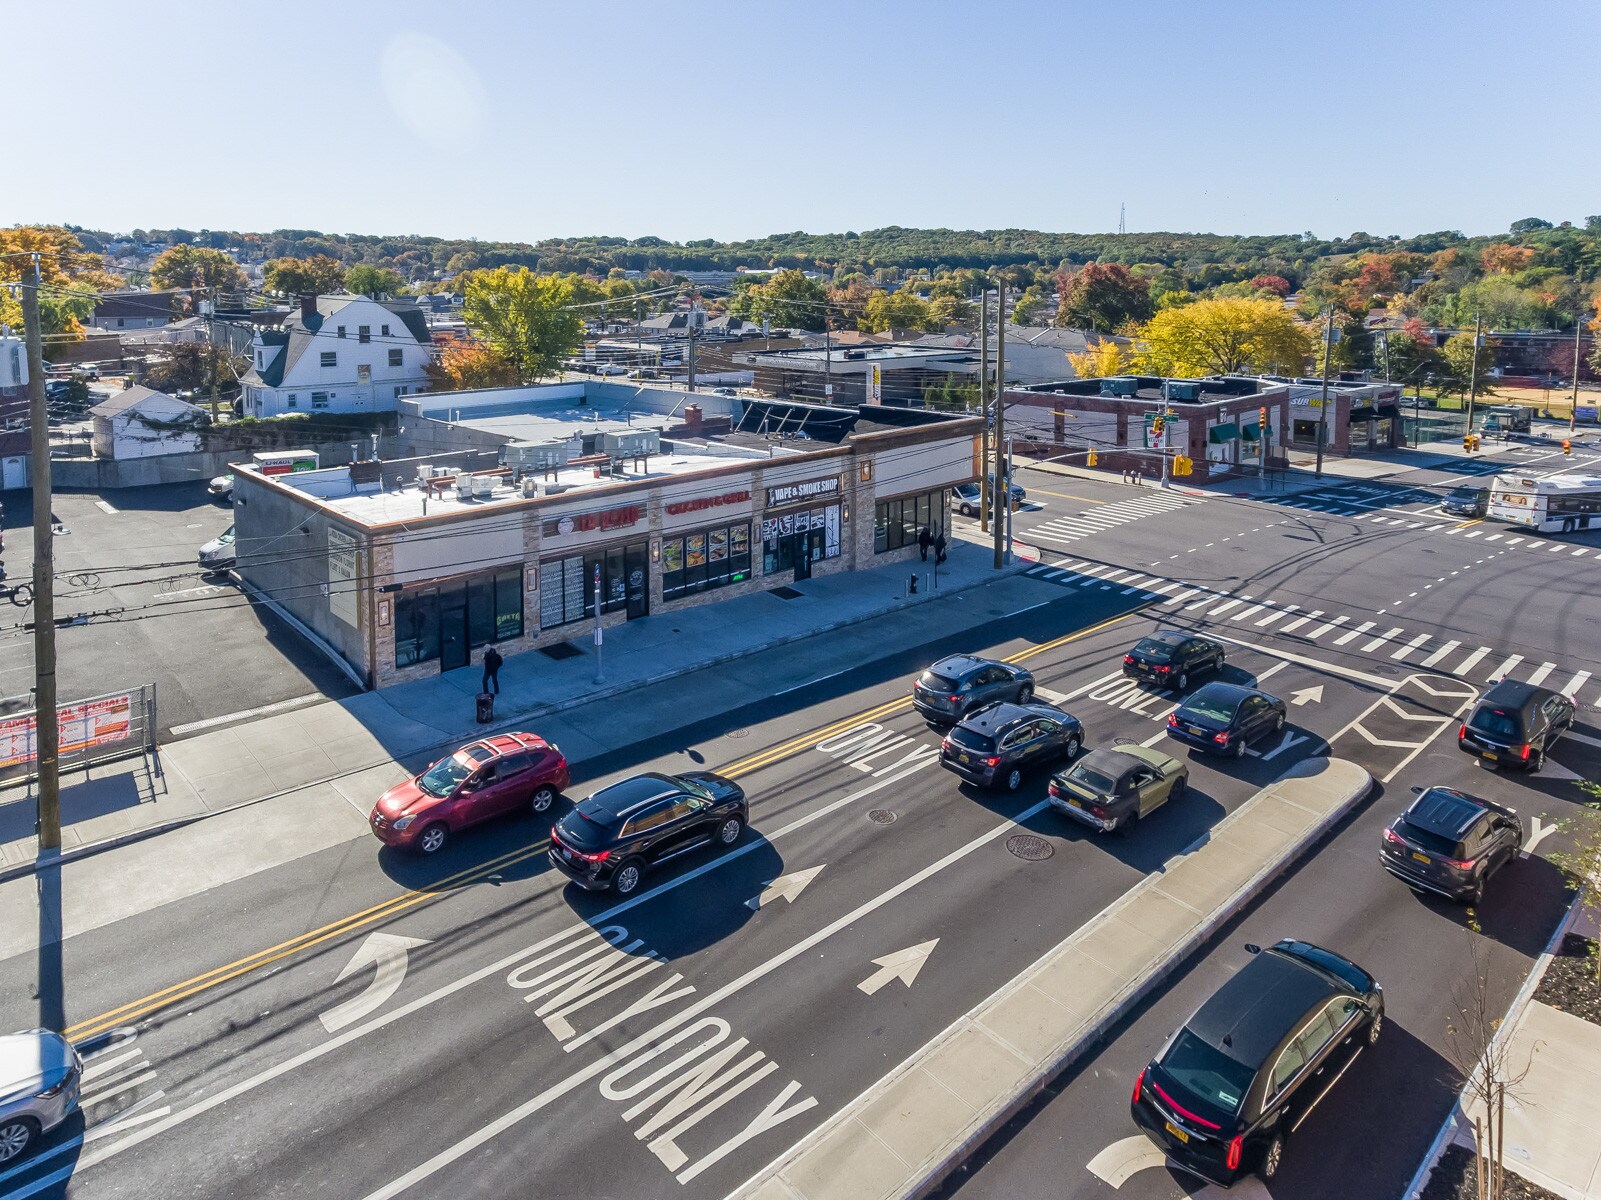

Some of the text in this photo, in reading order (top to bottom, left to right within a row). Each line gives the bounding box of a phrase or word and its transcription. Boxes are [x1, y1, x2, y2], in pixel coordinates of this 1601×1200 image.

[1290, 398, 1332, 408] SUBWA
[775, 487, 792, 500] VAPE
[792, 487, 798, 495] &
[799, 481, 820, 496] SMOKE
[821, 479, 838, 491] SHOP
[815, 722, 940, 777] ONLY
[506, 925, 697, 1053] ONLY
[599, 1016, 819, 1185] ONLY
